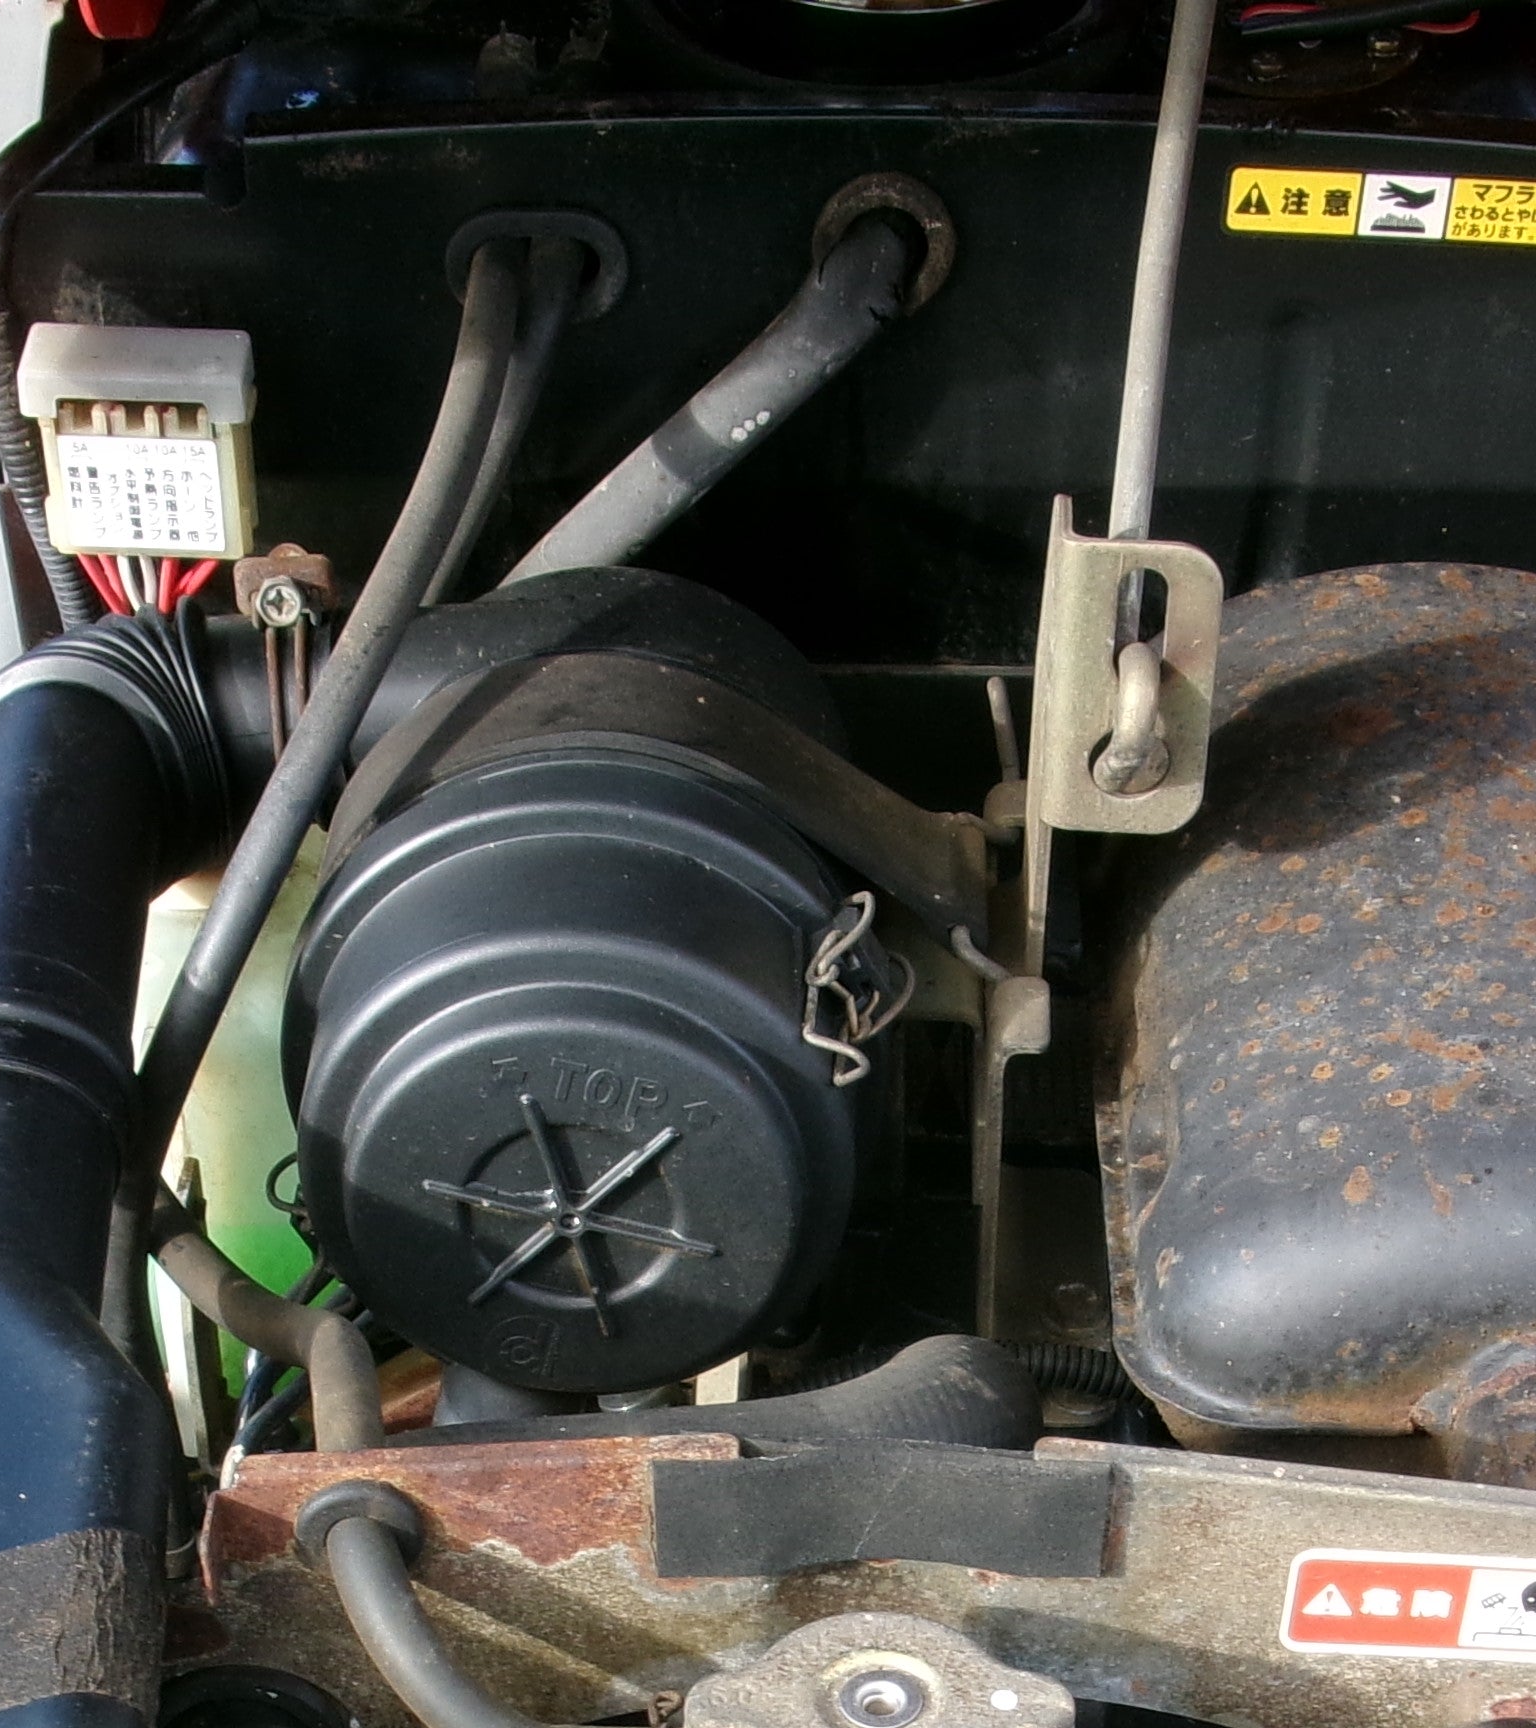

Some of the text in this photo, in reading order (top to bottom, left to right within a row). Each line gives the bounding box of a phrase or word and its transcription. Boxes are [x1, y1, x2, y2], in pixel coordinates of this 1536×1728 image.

[1280, 187, 1353, 216] 注意
[1452, 222, 1535, 241] があります。
[550, 1057, 669, 1118] TOP
[1359, 1586, 1454, 1619] 危険
